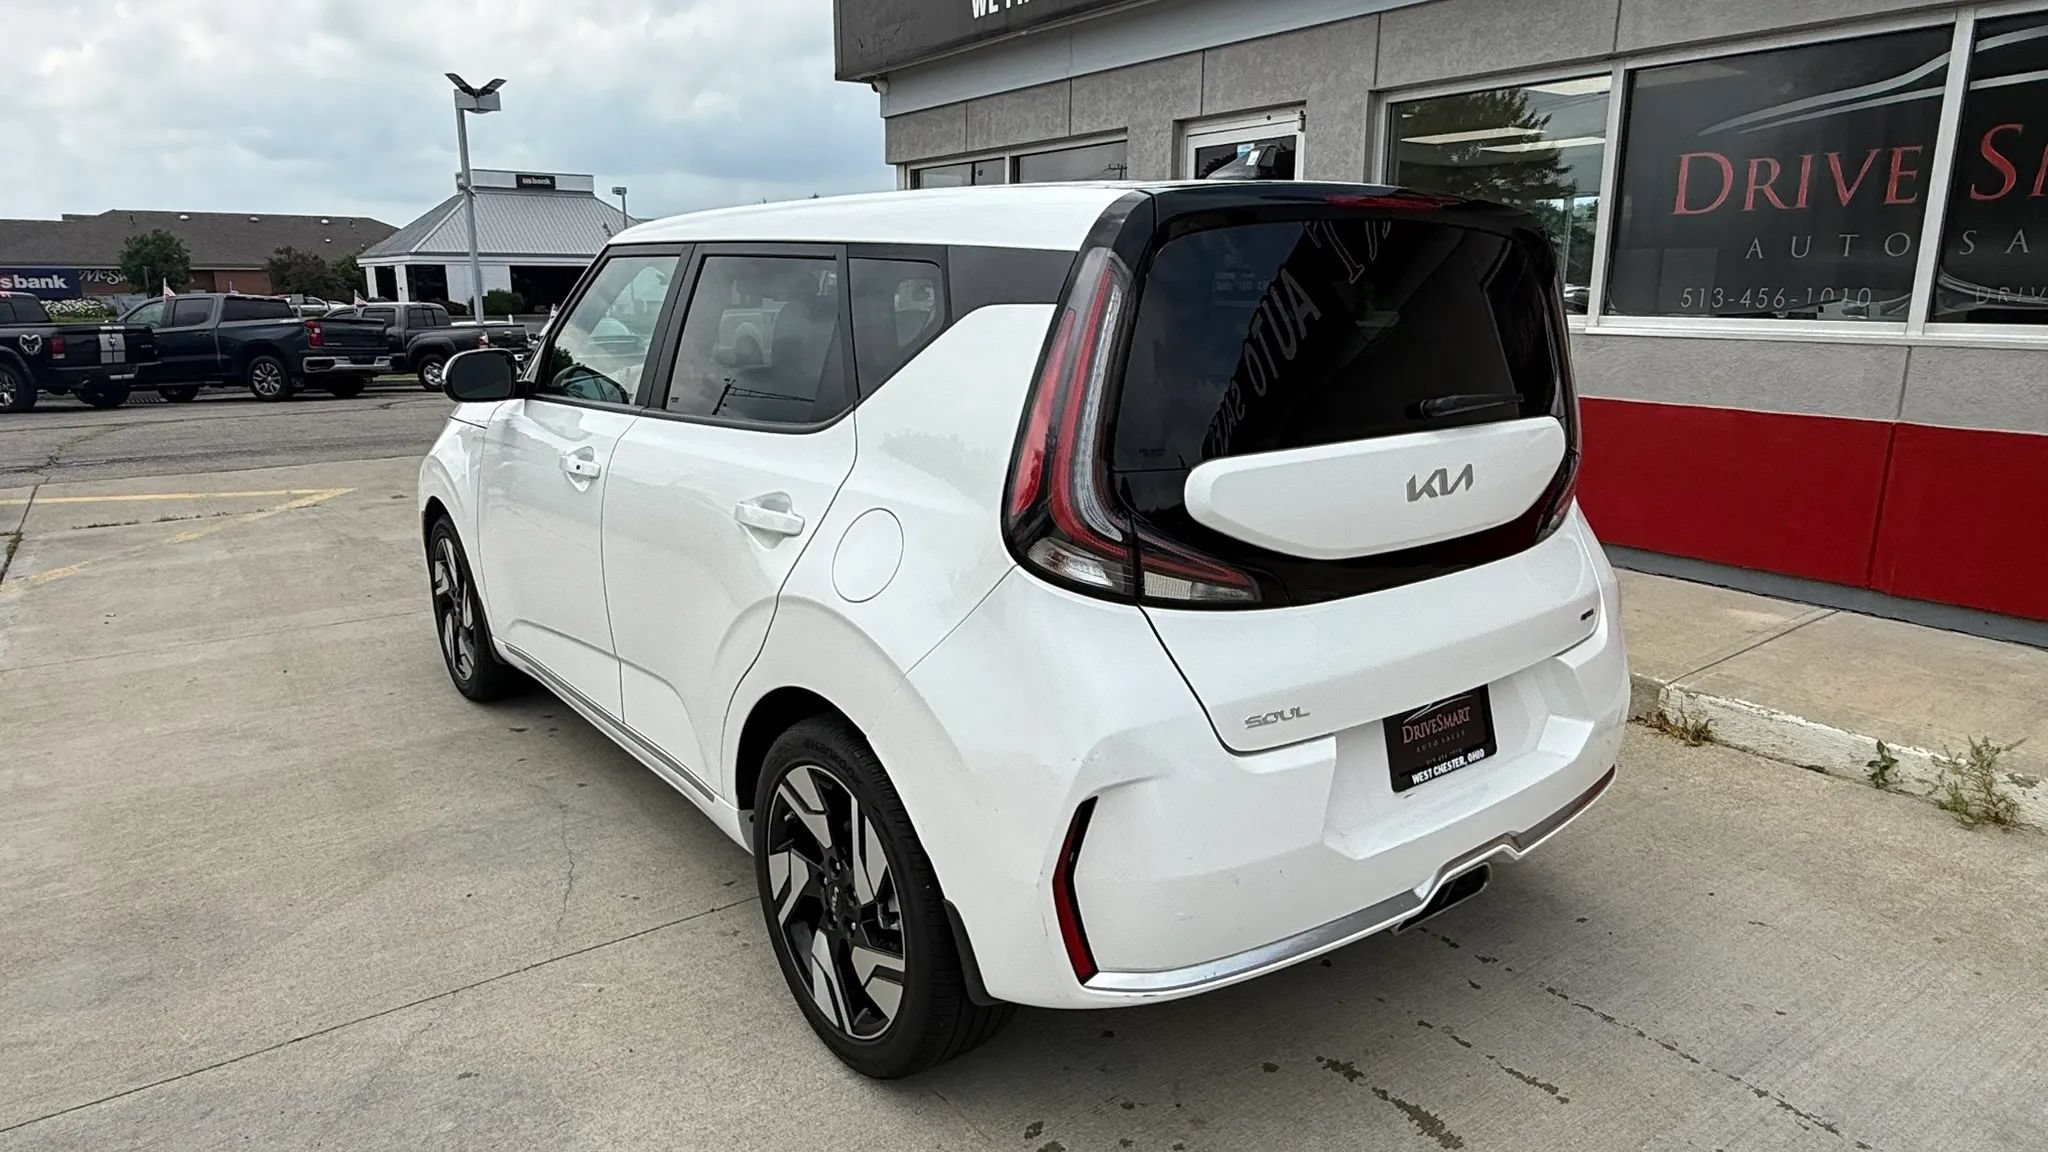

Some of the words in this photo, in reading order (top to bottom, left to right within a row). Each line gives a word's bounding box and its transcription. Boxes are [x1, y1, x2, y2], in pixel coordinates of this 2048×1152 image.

[1671, 145, 1923, 215] DRIVE
[1745, 231, 1911, 259] AUTO
[1959, 228, 2031, 255] SA
[1680, 287, 1872, 309] 513-456-1010
[1406, 463, 1473, 502] KIA
[1244, 706, 1311, 729] SOUL
[1411, 766, 1434, 784] WEST
[1467, 748, 1485, 762] OHIO
